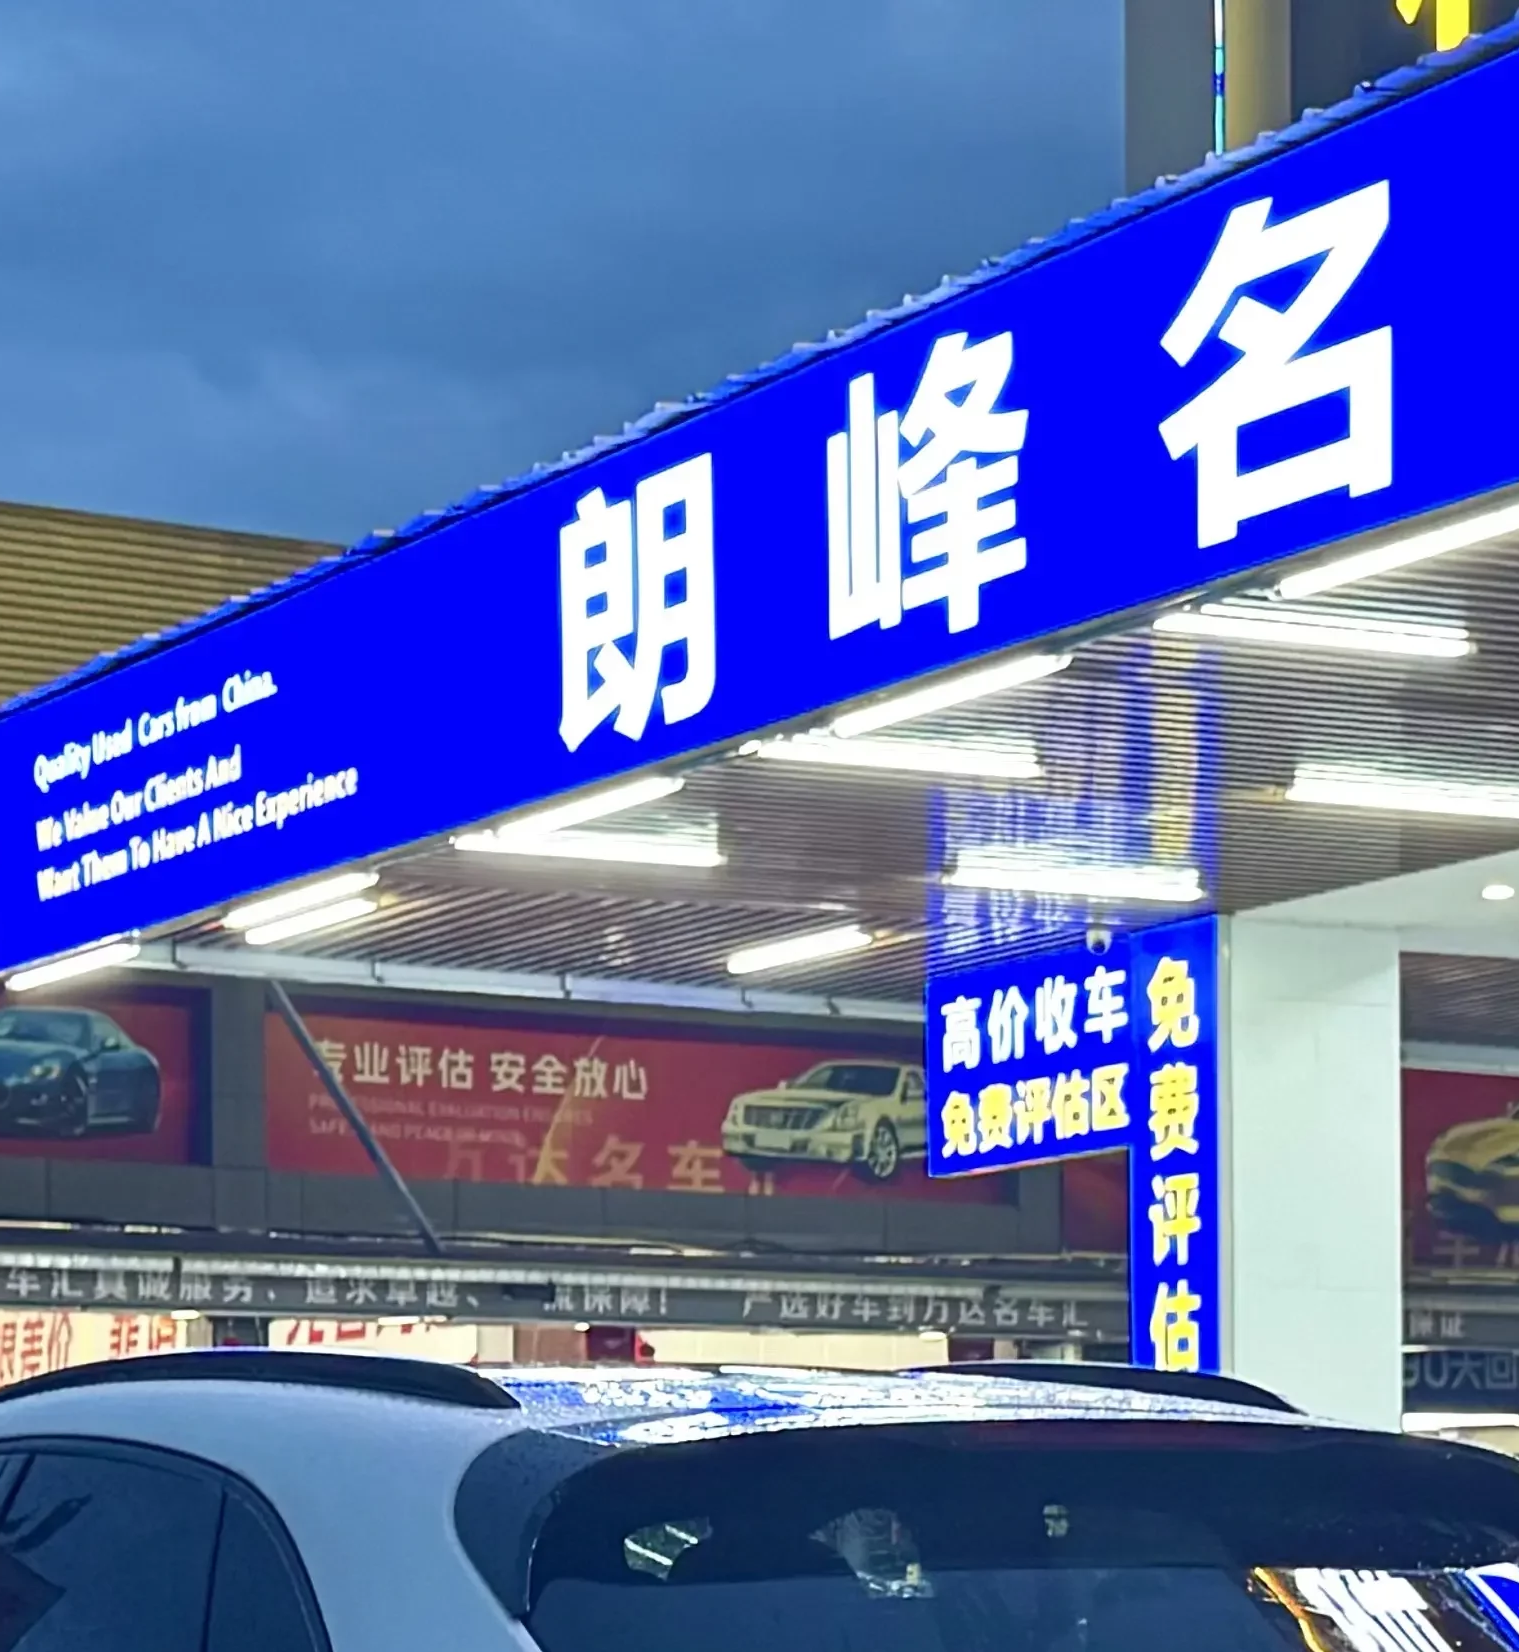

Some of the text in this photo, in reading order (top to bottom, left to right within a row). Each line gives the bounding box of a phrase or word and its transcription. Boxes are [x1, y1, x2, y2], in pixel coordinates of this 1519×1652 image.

[33, 741, 91, 793] Quality
[92, 719, 133, 764] Used
[137, 709, 174, 747] Cars
[176, 692, 217, 732] from
[36, 744, 242, 852] We Value Our Clients And
[37, 766, 359, 902] Want Them To Have A Nice Experience
[941, 965, 1130, 1073] 高价收车
[490, 1052, 648, 1101] 安全放心
[940, 1062, 1131, 1158] 免费评估区
[1147, 956, 1202, 1373] 免费评估
